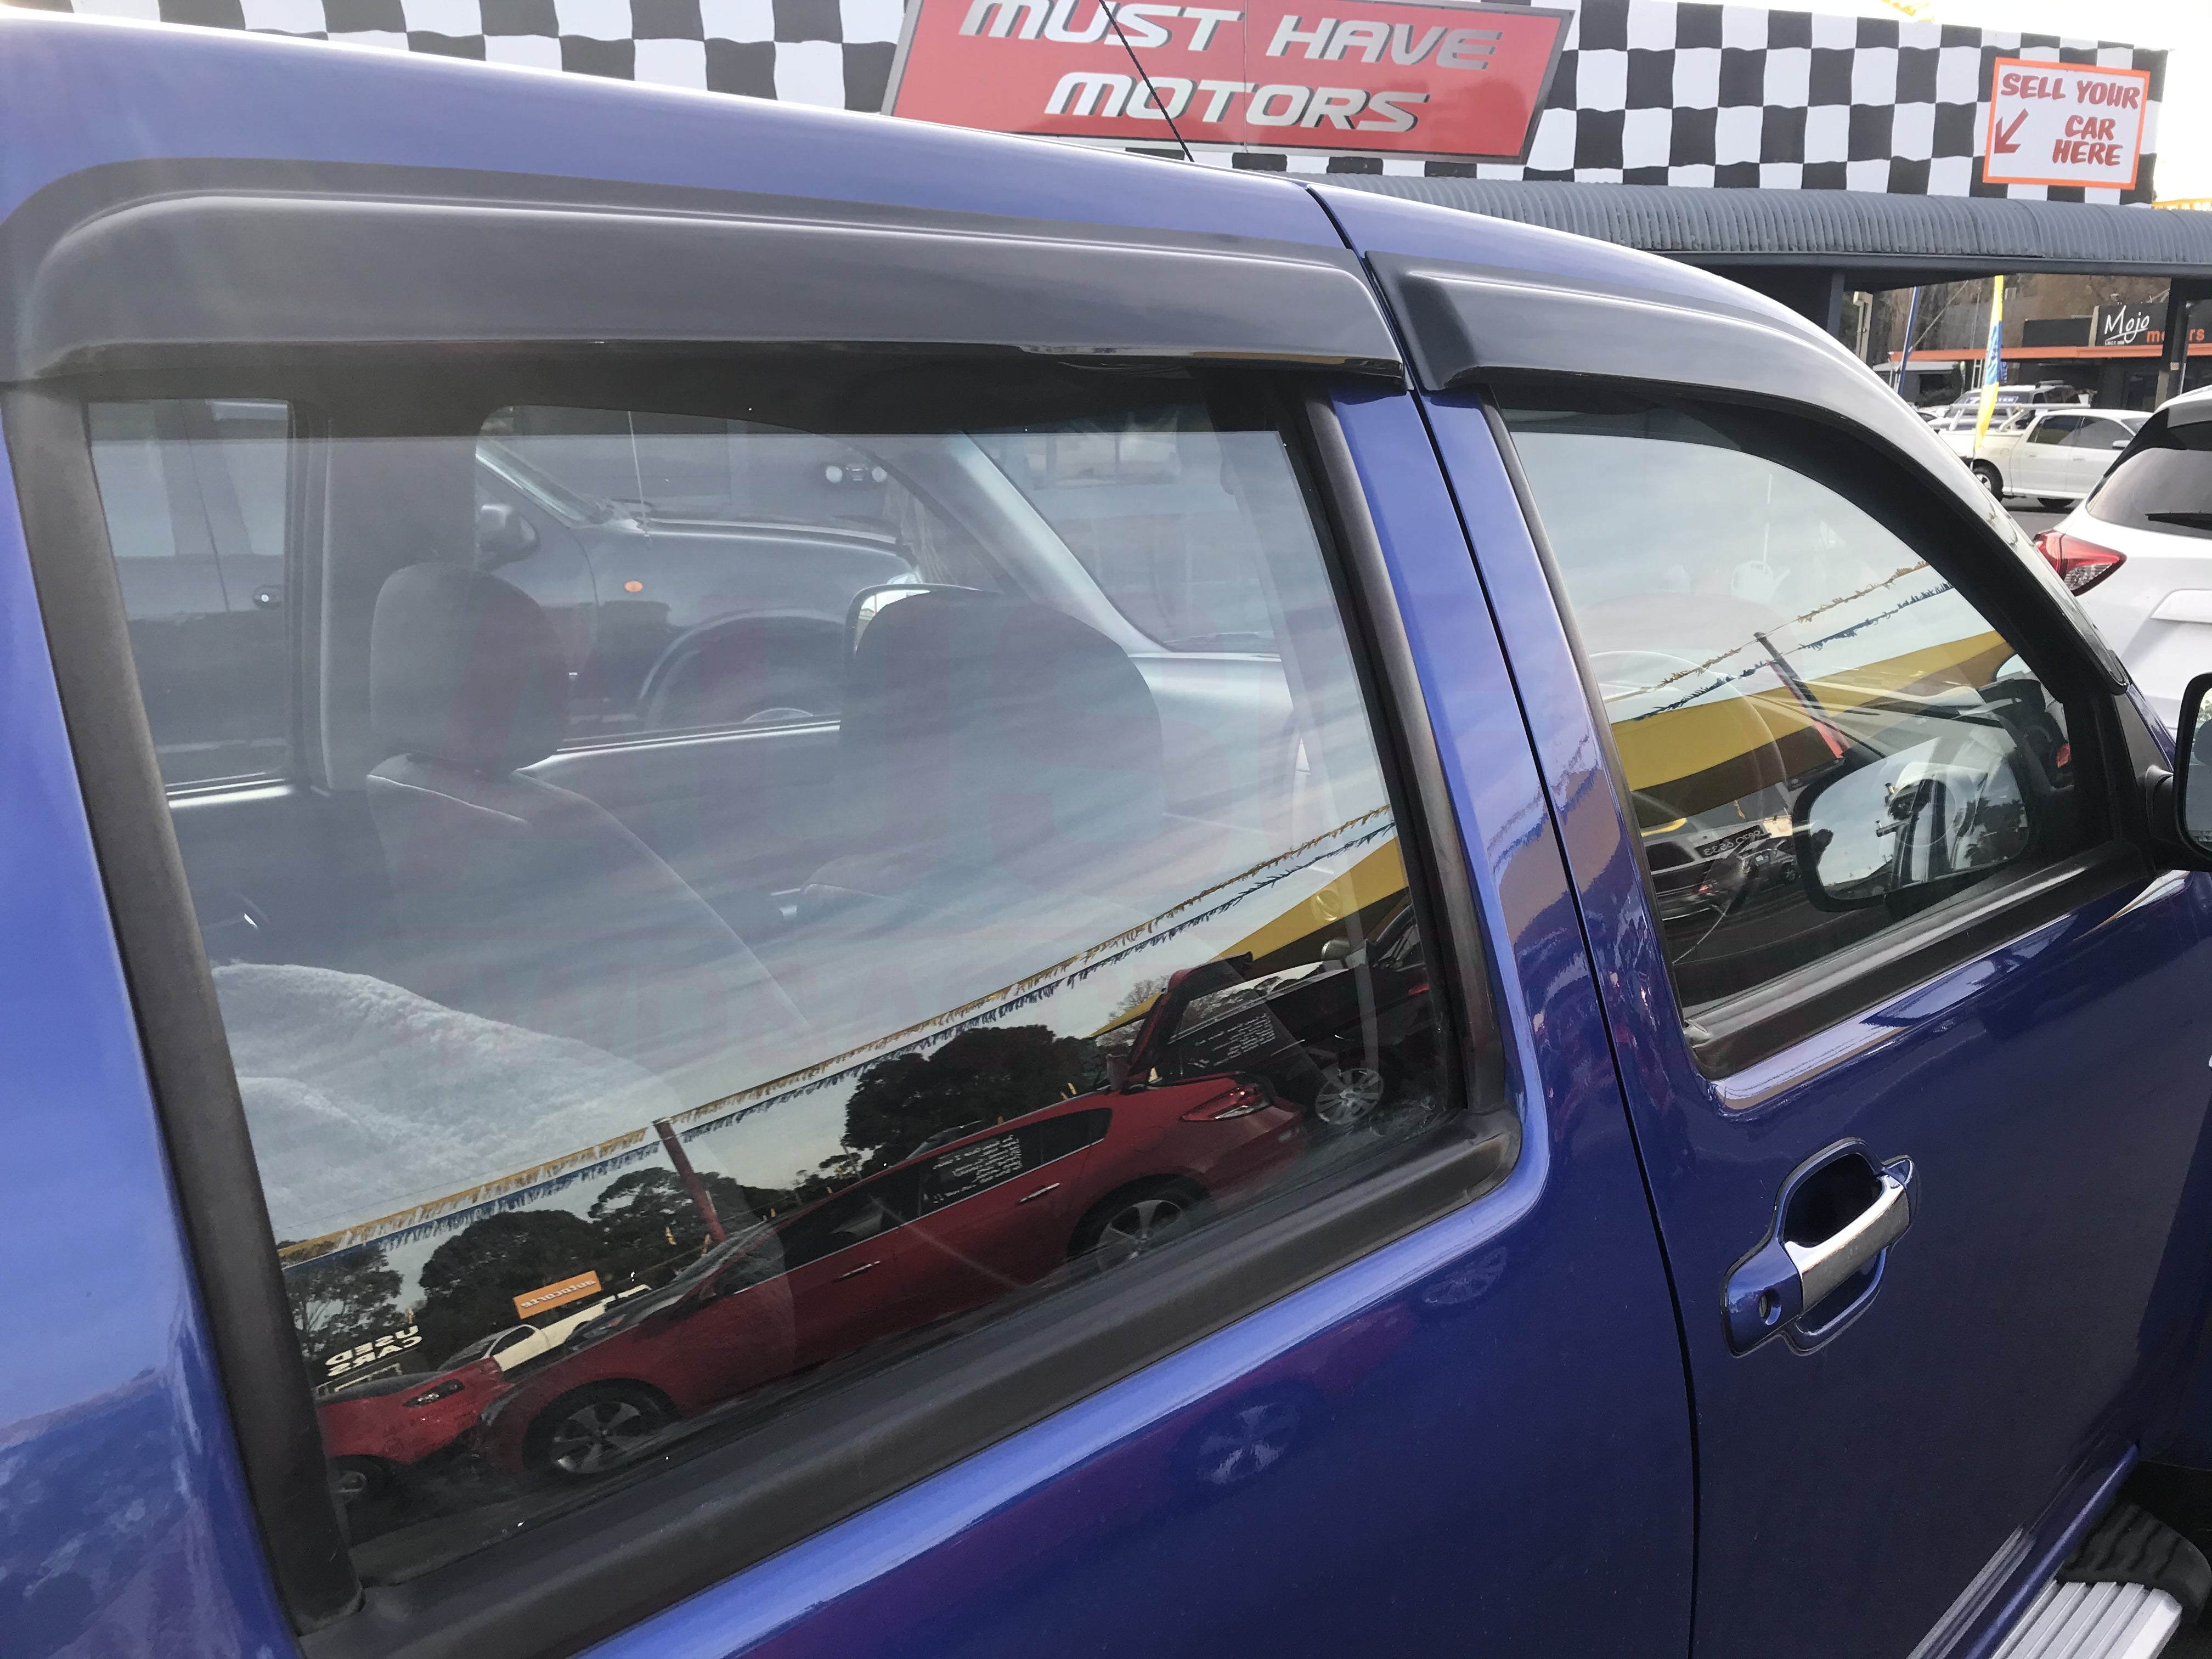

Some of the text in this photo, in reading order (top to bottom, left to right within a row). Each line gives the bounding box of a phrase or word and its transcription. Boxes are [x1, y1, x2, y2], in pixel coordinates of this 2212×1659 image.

[959, 0, 1503, 70] MUST HAVE
[1045, 72, 1431, 132] MOTORS
[2001, 73, 2140, 109] SELL YOUR
[2065, 115, 2116, 140] CAR
[2052, 139, 2124, 166] HERE
[2104, 305, 2149, 343] Mojo
